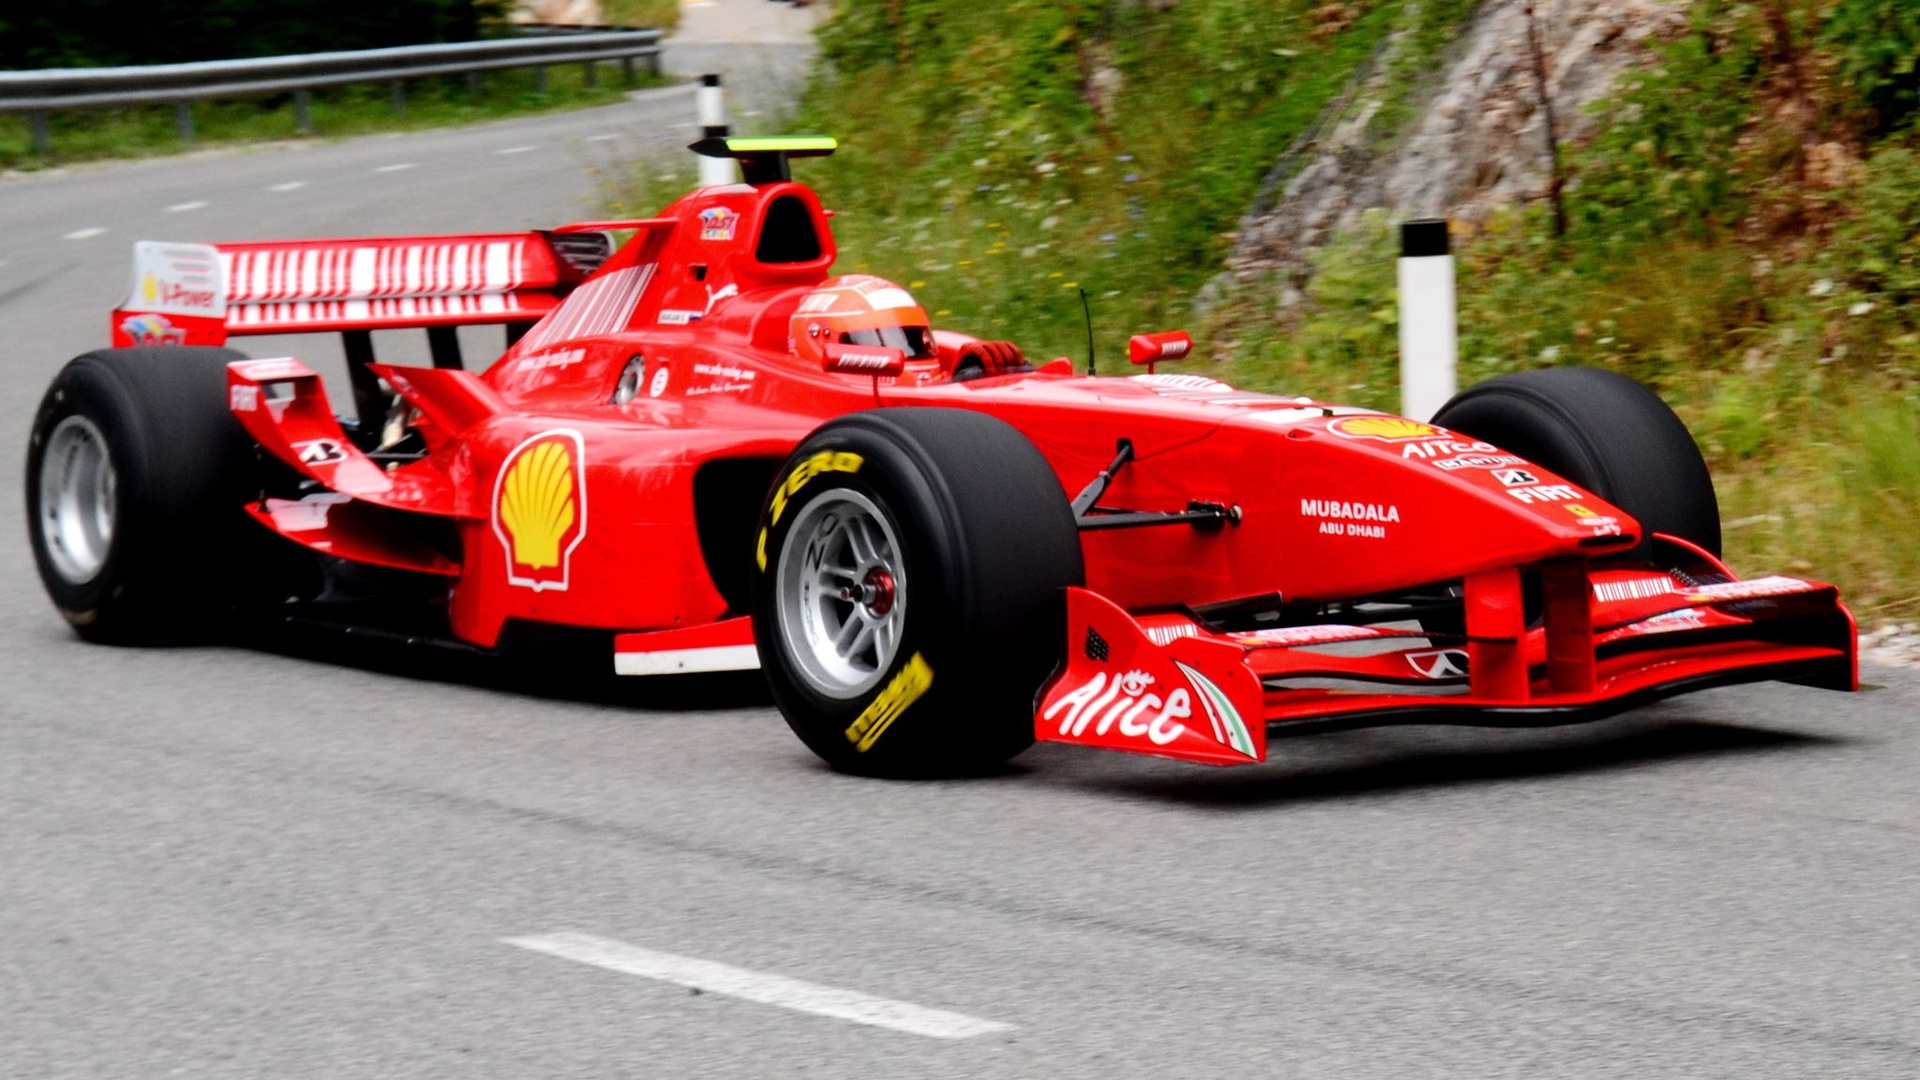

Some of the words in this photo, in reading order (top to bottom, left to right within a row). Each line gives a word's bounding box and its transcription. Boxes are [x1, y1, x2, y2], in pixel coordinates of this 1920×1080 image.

[769, 450, 865, 527] ZERO
[1506, 484, 1584, 503] FIAT
[1300, 498, 1401, 523] MUBADALA
[1319, 521, 1344, 535] ABU
[1346, 523, 1385, 539] DHABI
[1043, 670, 1193, 745] Alice
